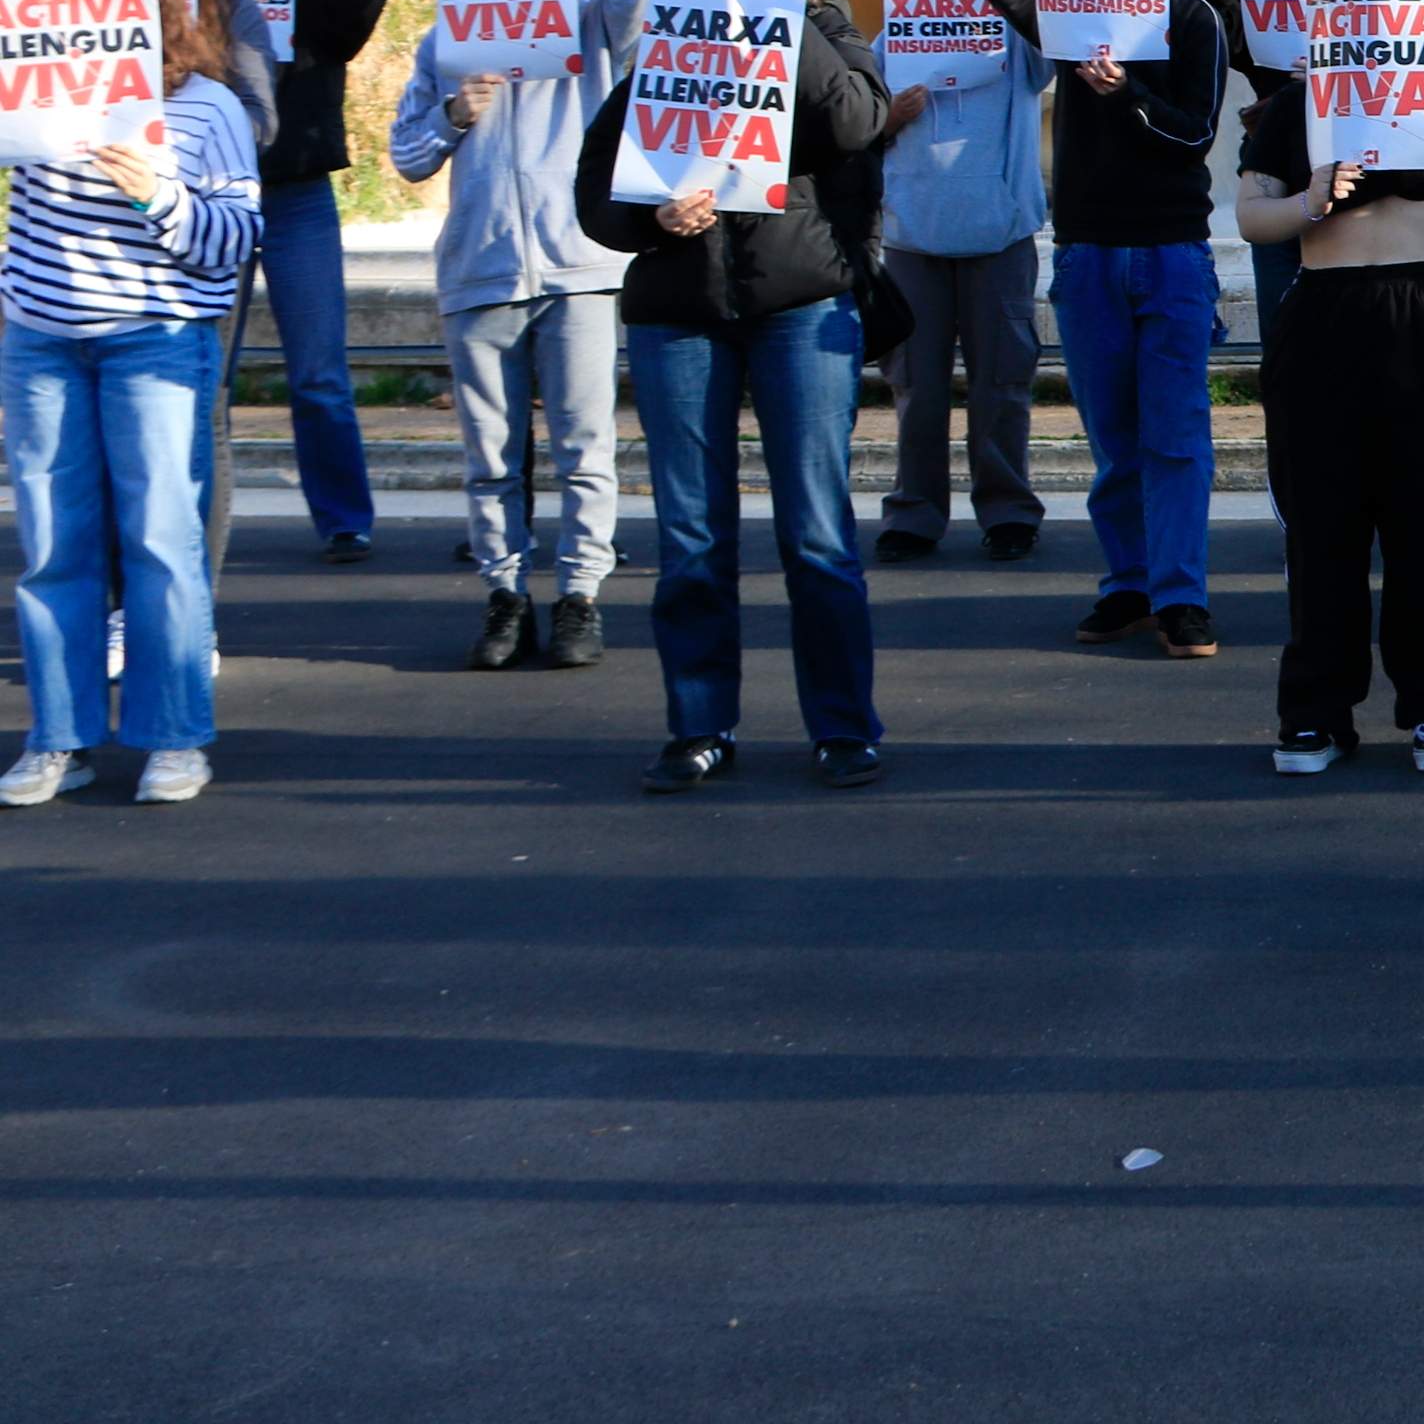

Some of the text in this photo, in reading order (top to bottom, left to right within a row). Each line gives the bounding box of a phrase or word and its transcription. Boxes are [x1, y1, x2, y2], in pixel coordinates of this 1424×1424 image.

[443, 0, 573, 42] VIVA
[648, 5, 792, 47] XARXA
[888, 21, 1004, 37] DE CENTRES
[643, 39, 788, 82] ACTIVA
[888, 38, 1004, 53] INSUBMISOS
[636, 74, 785, 112] LLENGUA
[635, 104, 782, 162] VIVA
